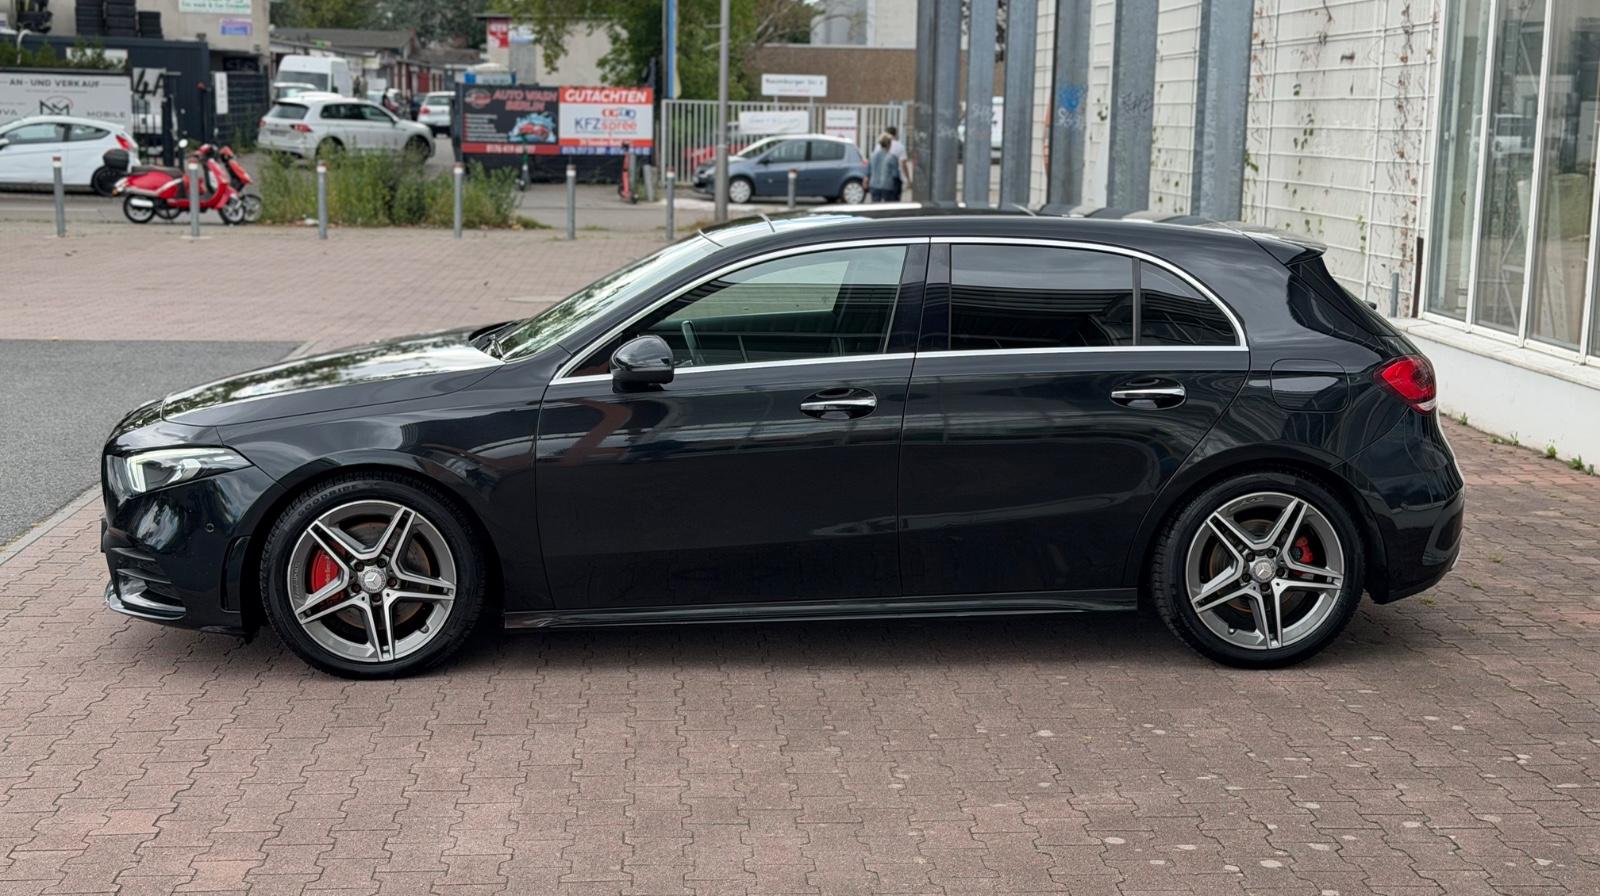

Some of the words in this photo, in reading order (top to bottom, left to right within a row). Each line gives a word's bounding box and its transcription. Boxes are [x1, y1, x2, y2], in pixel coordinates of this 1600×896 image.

[30, 79, 52, 87] UND
[55, 79, 100, 88] VERKAUF
[493, 88, 524, 100] AUTO
[525, 89, 558, 102] WASH
[564, 88, 647, 102] GUTACHTEN
[505, 100, 546, 111] BERLIN
